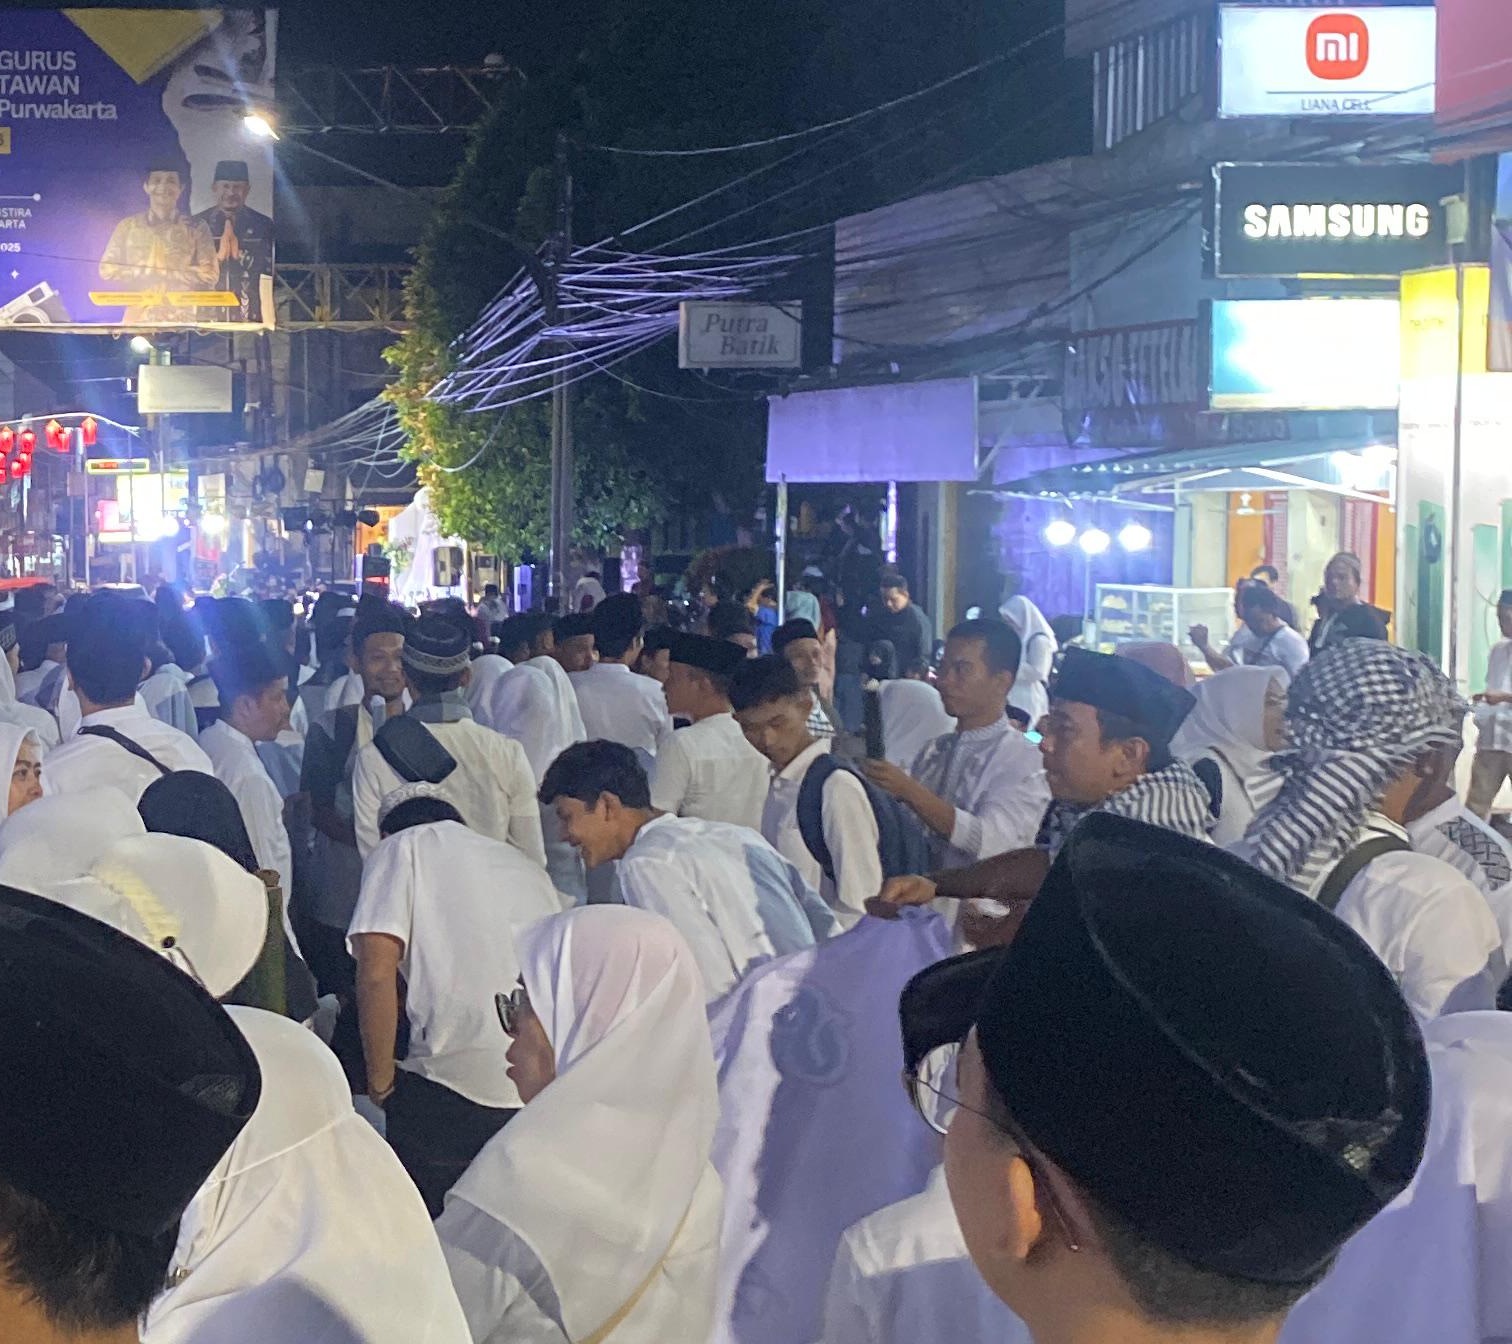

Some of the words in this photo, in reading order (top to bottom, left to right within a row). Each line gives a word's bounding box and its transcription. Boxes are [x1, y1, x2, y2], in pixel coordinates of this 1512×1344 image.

[1301, 98, 1339, 111] LIANA
[1244, 204, 1429, 238] SAMSUNG
[701, 313, 768, 334] Putra
[720, 334, 779, 355] Batik
